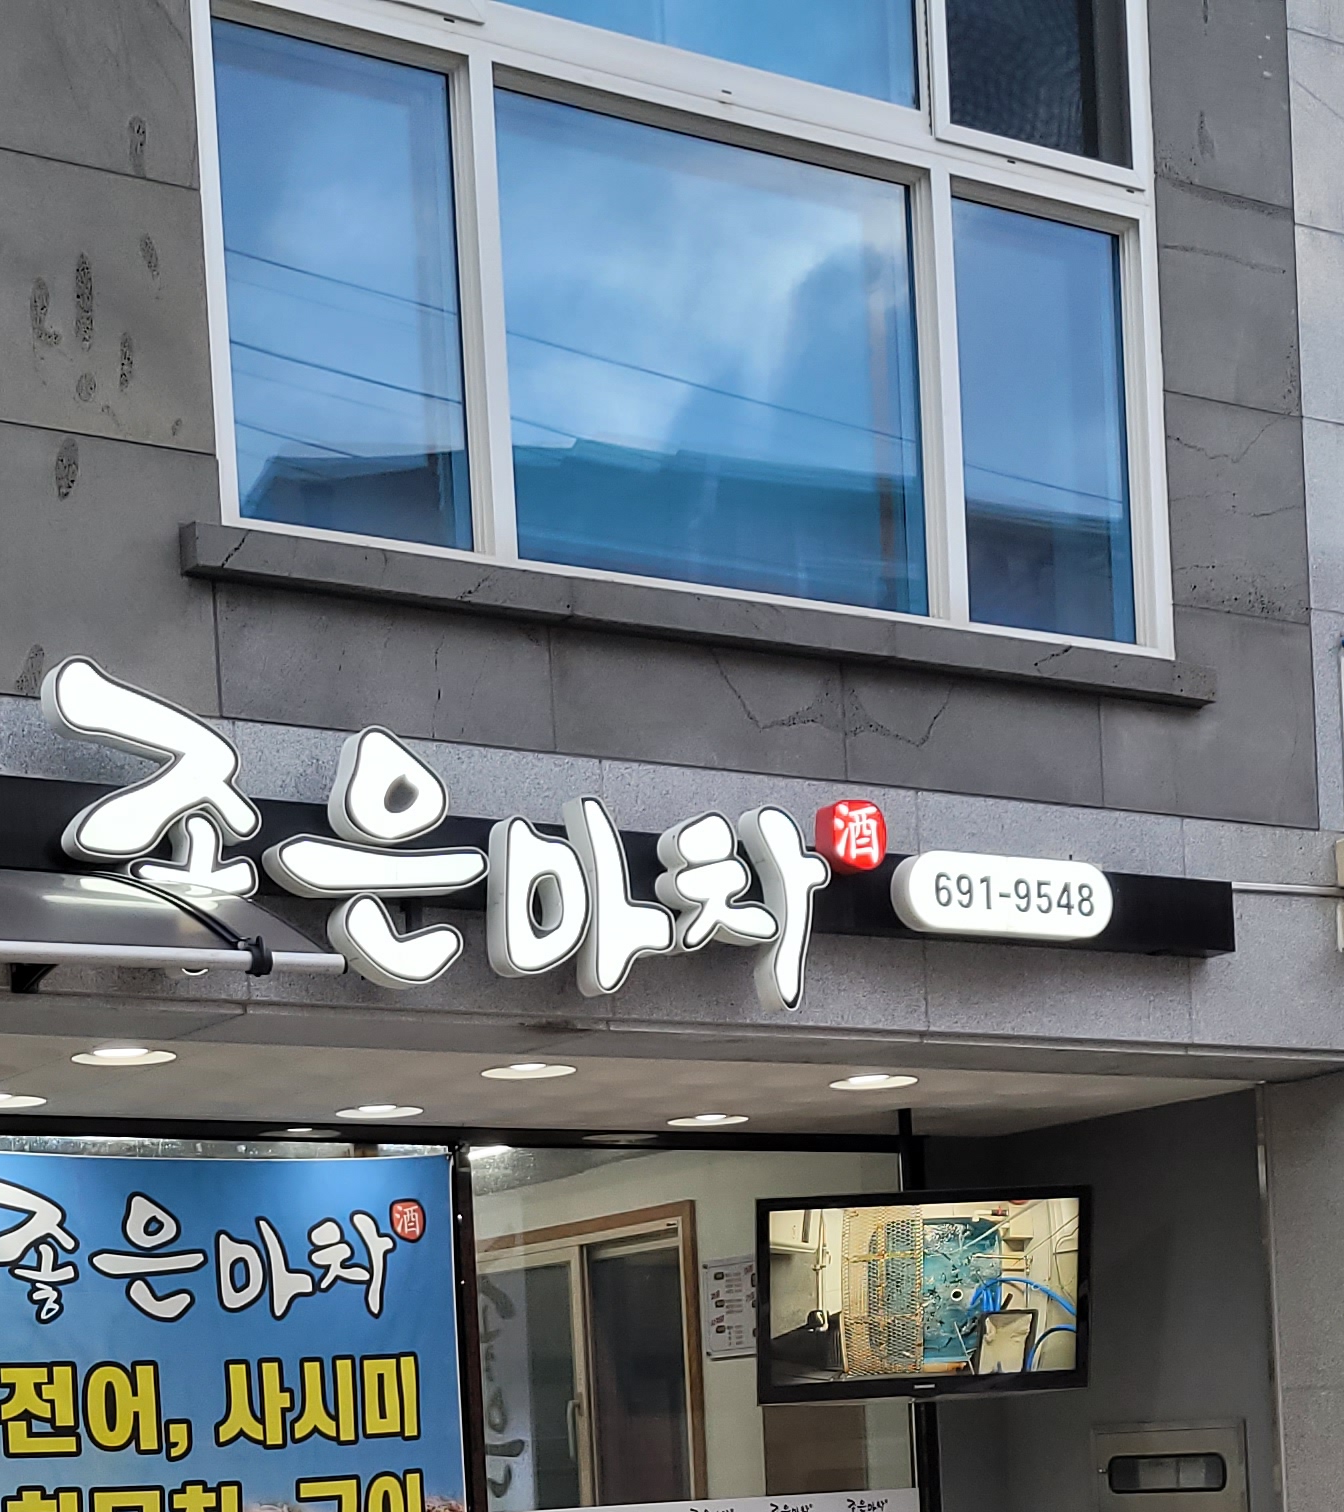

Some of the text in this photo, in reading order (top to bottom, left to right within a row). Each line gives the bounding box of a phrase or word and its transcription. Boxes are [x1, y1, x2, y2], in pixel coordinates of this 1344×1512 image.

[824, 802, 886, 868] 酒
[933, 872, 1097, 920] 691-9548
[216, 1353, 420, 1449] 사시미
